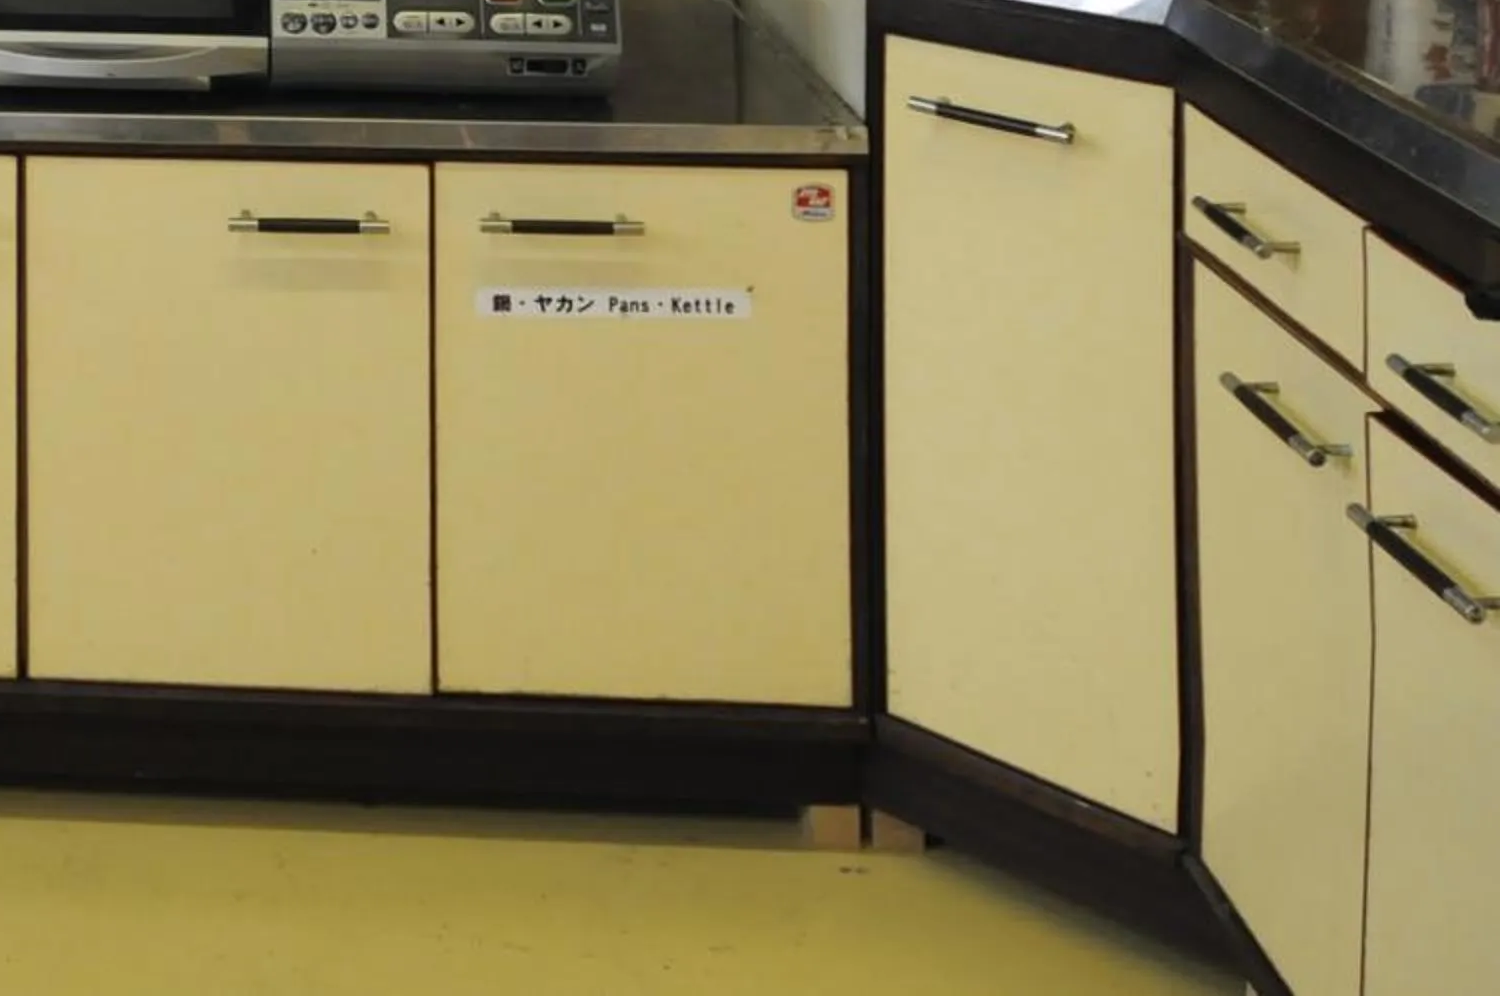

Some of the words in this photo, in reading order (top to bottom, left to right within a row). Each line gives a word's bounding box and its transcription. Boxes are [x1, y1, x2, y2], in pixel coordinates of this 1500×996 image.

[492, 294, 595, 314] 鍋・ヤカン
